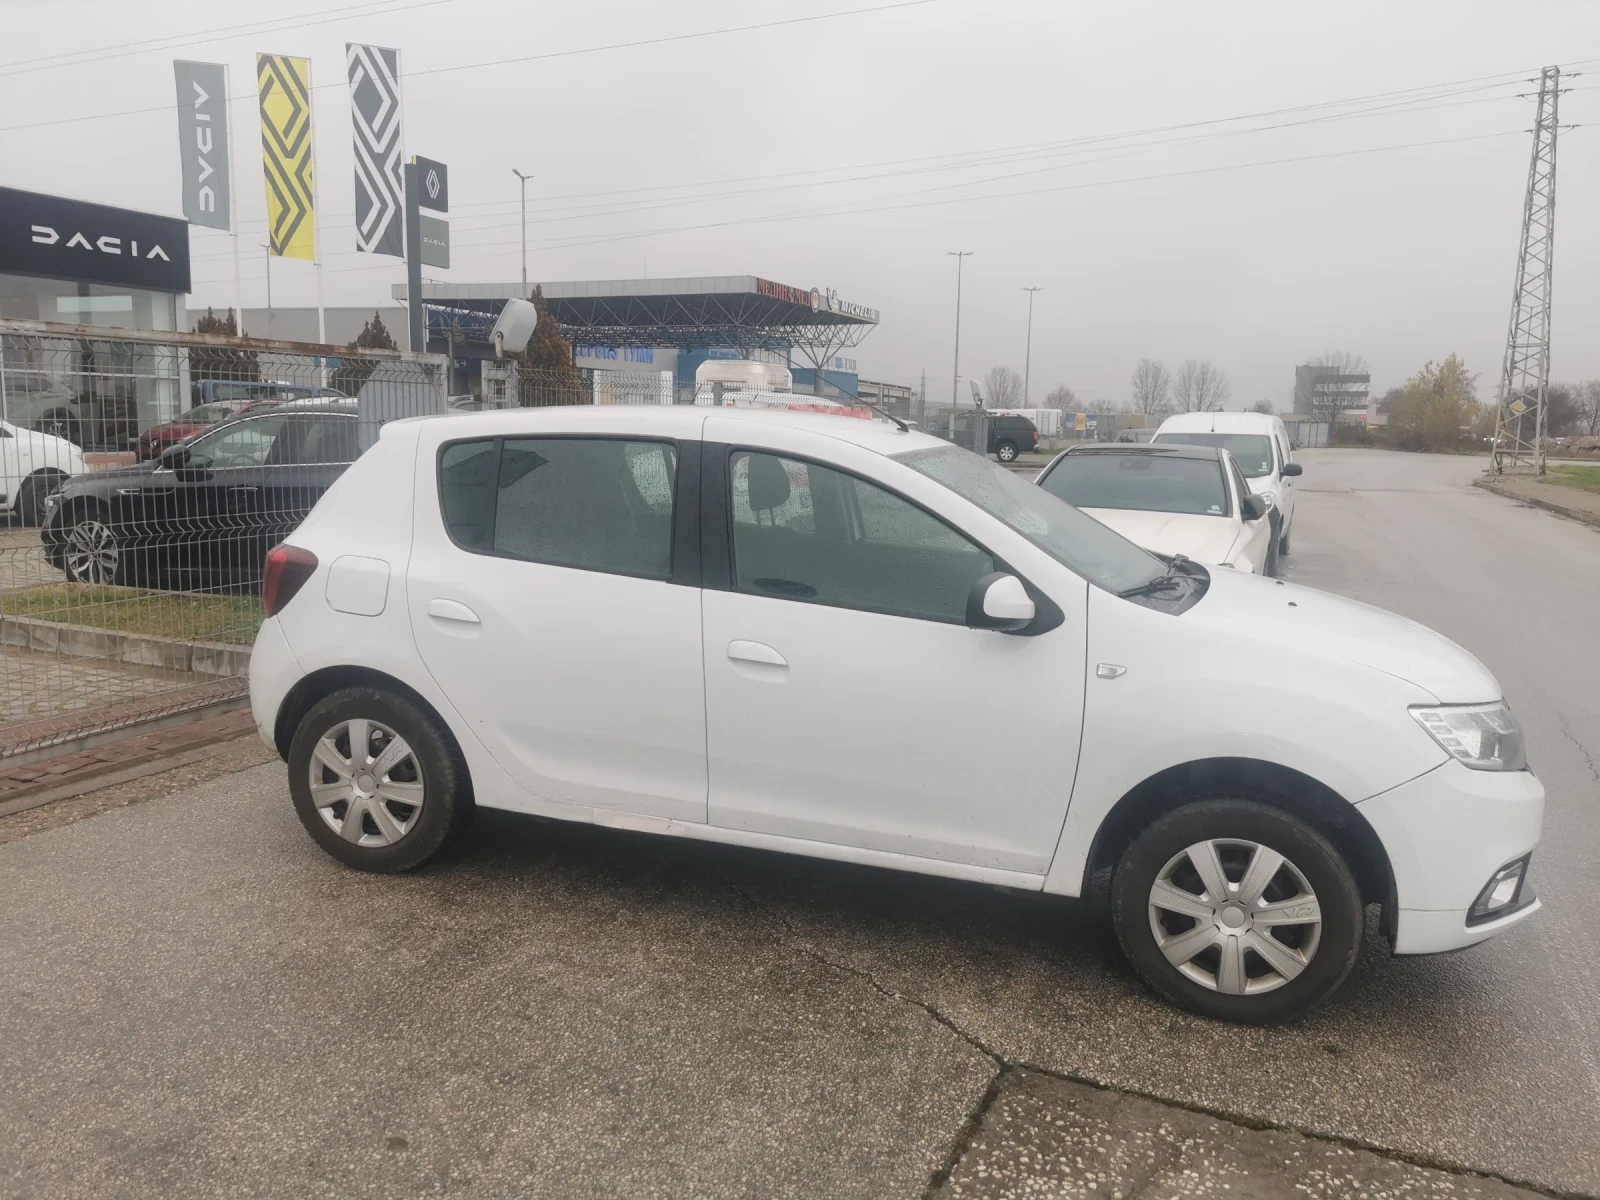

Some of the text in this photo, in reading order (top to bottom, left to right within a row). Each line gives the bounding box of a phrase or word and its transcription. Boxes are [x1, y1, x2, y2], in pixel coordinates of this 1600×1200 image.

[192, 80, 215, 213] DACIA
[31, 224, 171, 262] DACIA
[423, 236, 446, 247] DACIA
[840, 301, 876, 320] MICHELIN
